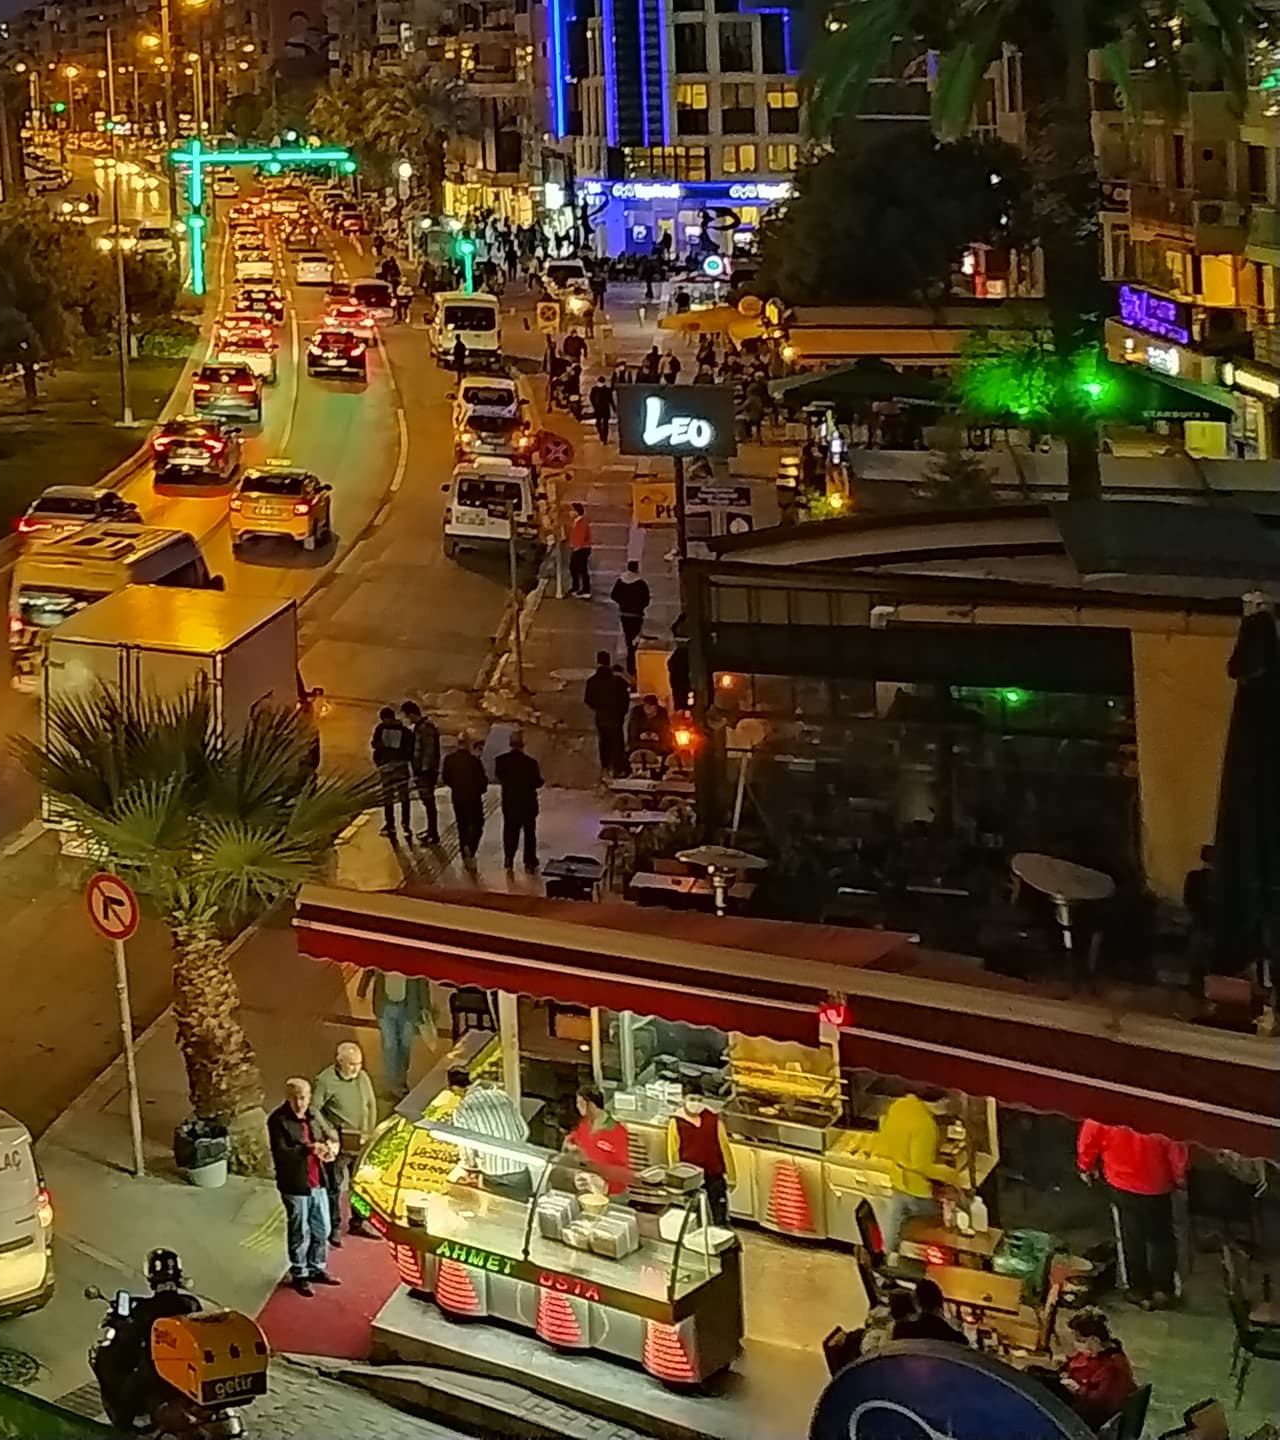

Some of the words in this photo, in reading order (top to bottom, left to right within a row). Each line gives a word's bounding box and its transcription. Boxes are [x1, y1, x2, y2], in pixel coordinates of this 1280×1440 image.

[436, 1241, 516, 1274] AHMET
[539, 1271, 600, 1301] USTA
[214, 1375, 253, 1400] getir
